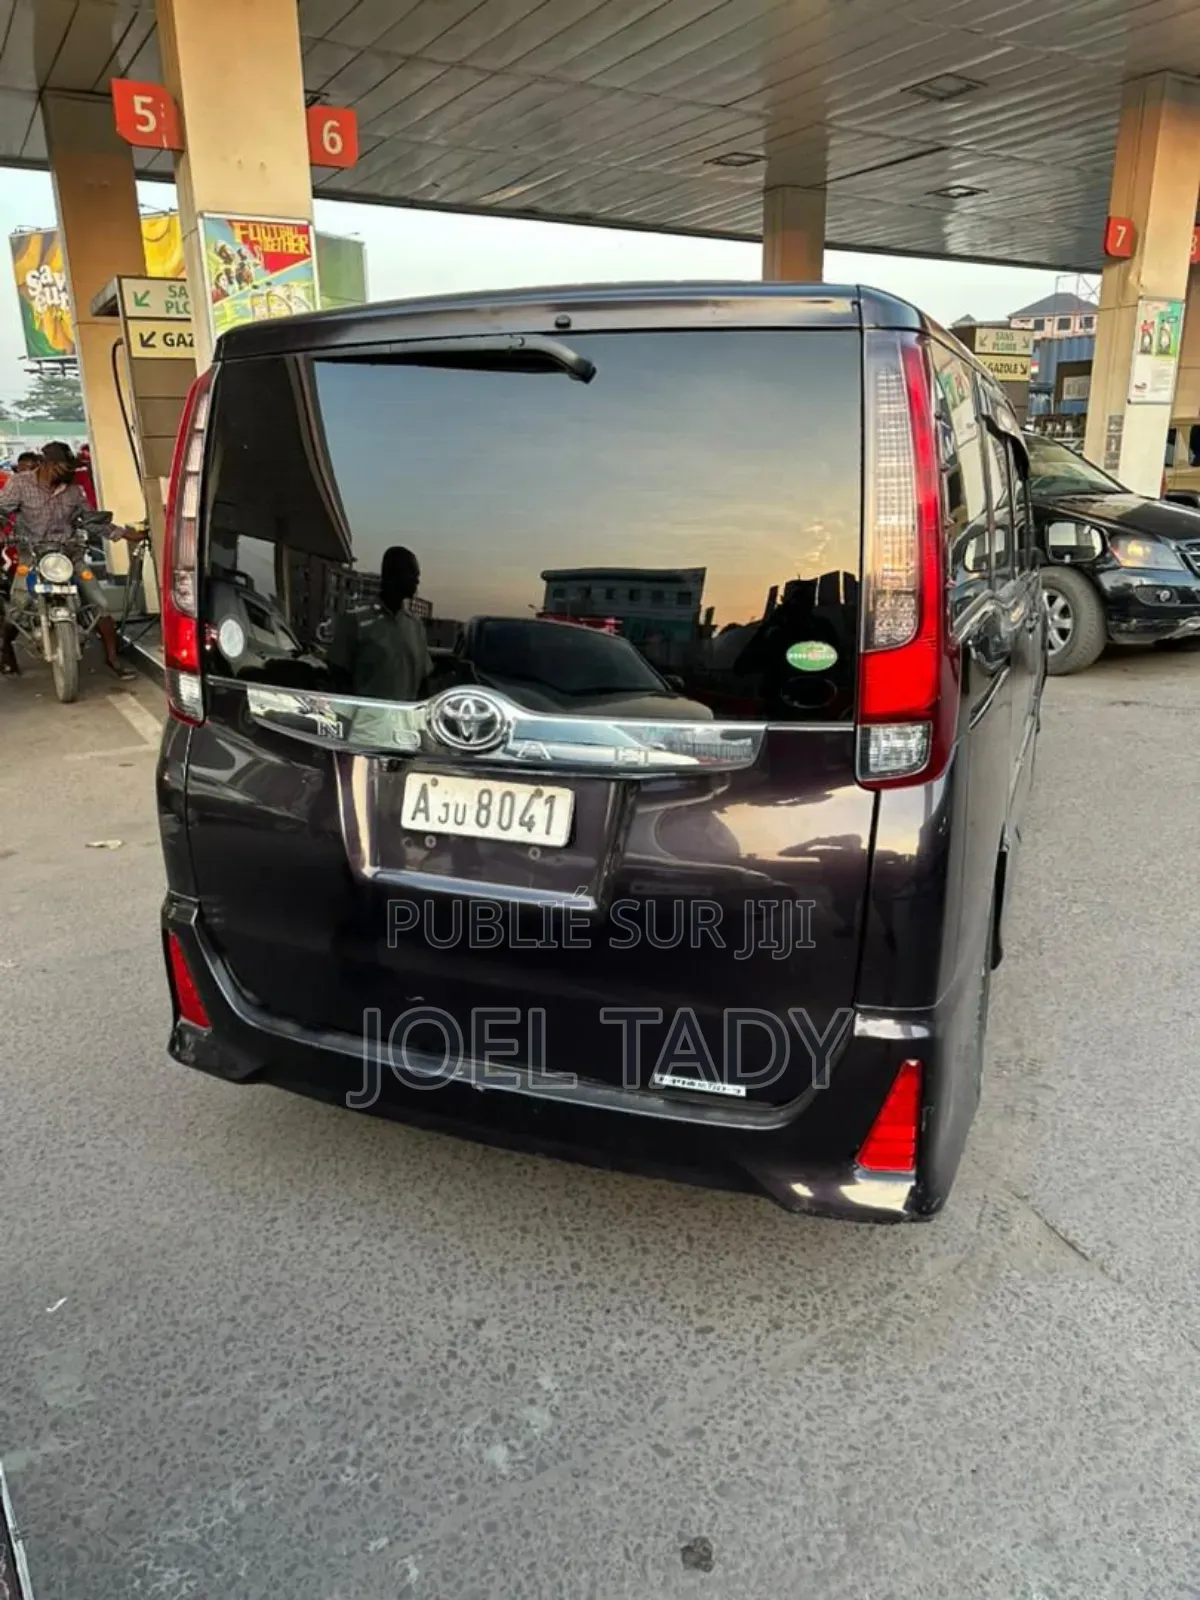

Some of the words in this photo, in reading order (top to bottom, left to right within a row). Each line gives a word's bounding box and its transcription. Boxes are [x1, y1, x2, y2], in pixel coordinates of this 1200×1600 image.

[132, 94, 157, 133] 5
[322, 120, 343, 155] 6
[1116, 225, 1127, 248] 7
